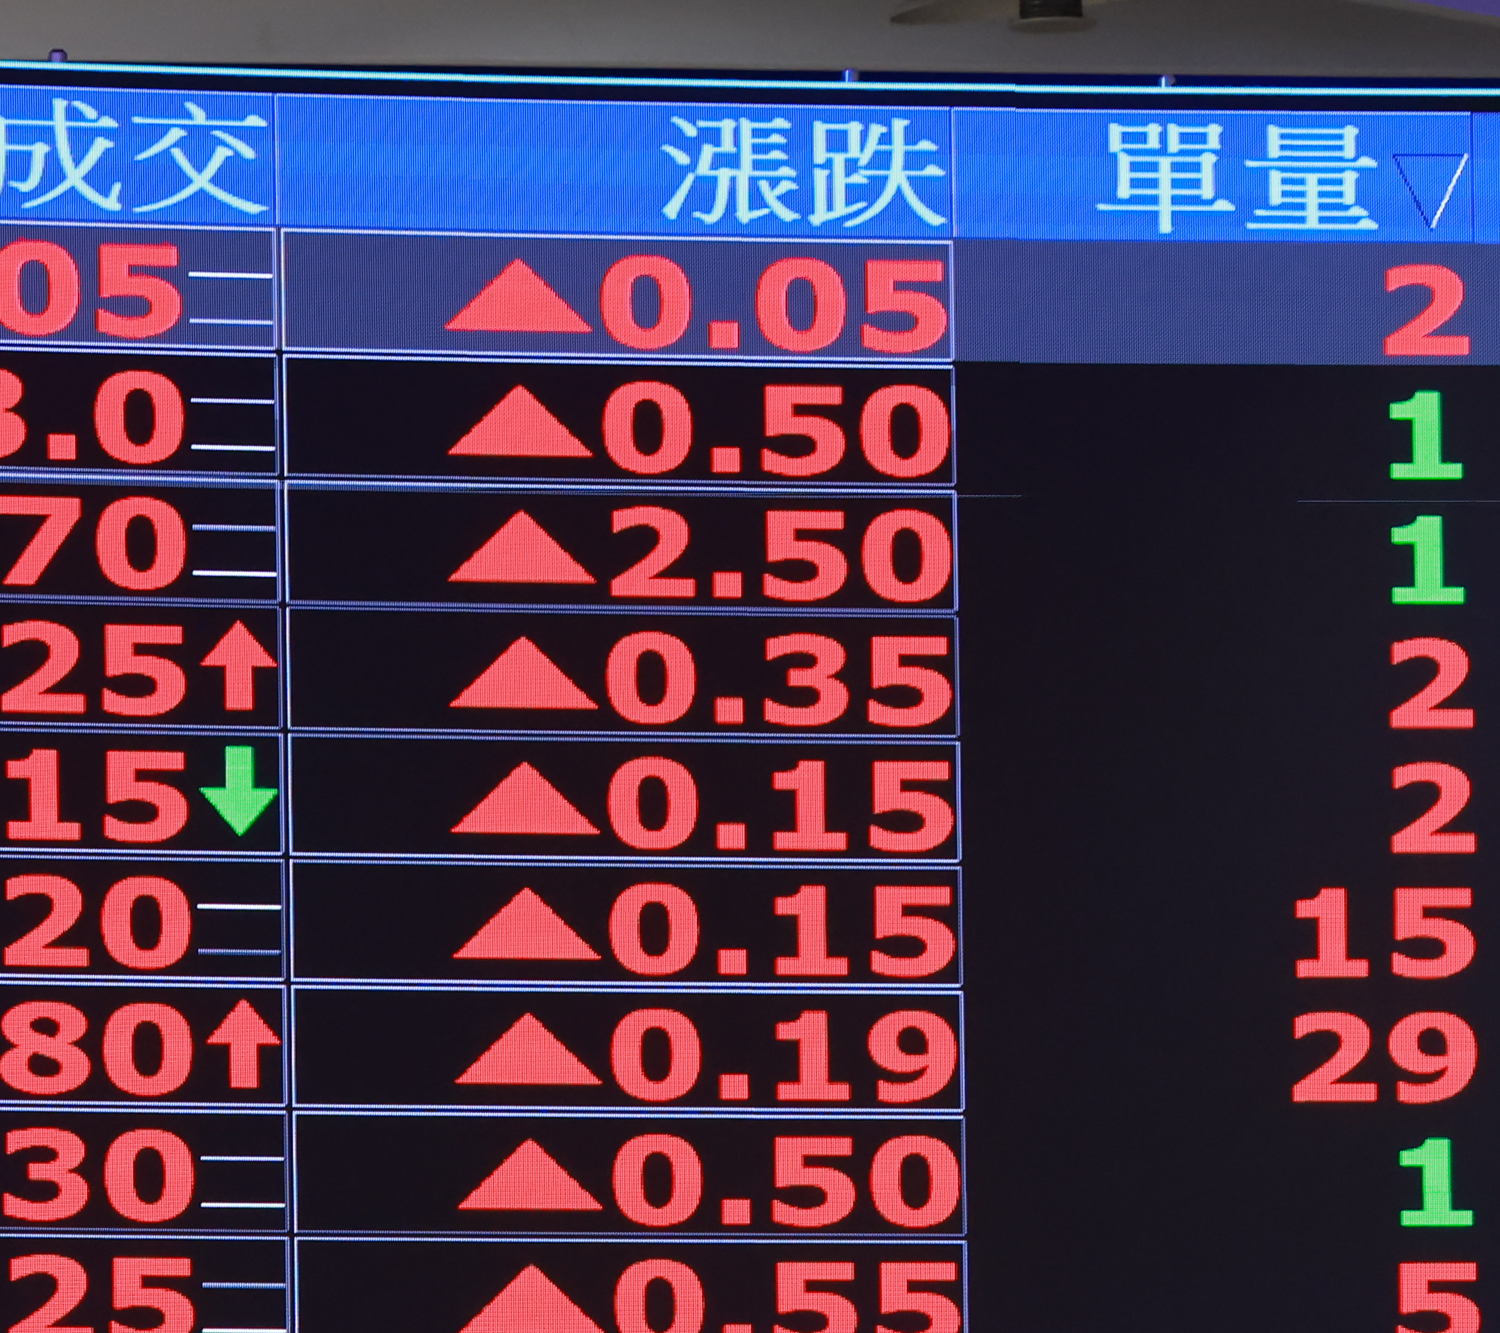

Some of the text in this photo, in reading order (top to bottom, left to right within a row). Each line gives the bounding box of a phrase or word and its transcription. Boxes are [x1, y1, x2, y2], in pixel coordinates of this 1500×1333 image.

[663, 117, 945, 226] 漲跌
[1098, 124, 1378, 233] 單量
[600, 255, 948, 353] 0.05
[1384, 264, 1470, 356] 2
[606, 756, 954, 853] 0.15
[1390, 761, 1477, 854] 2
